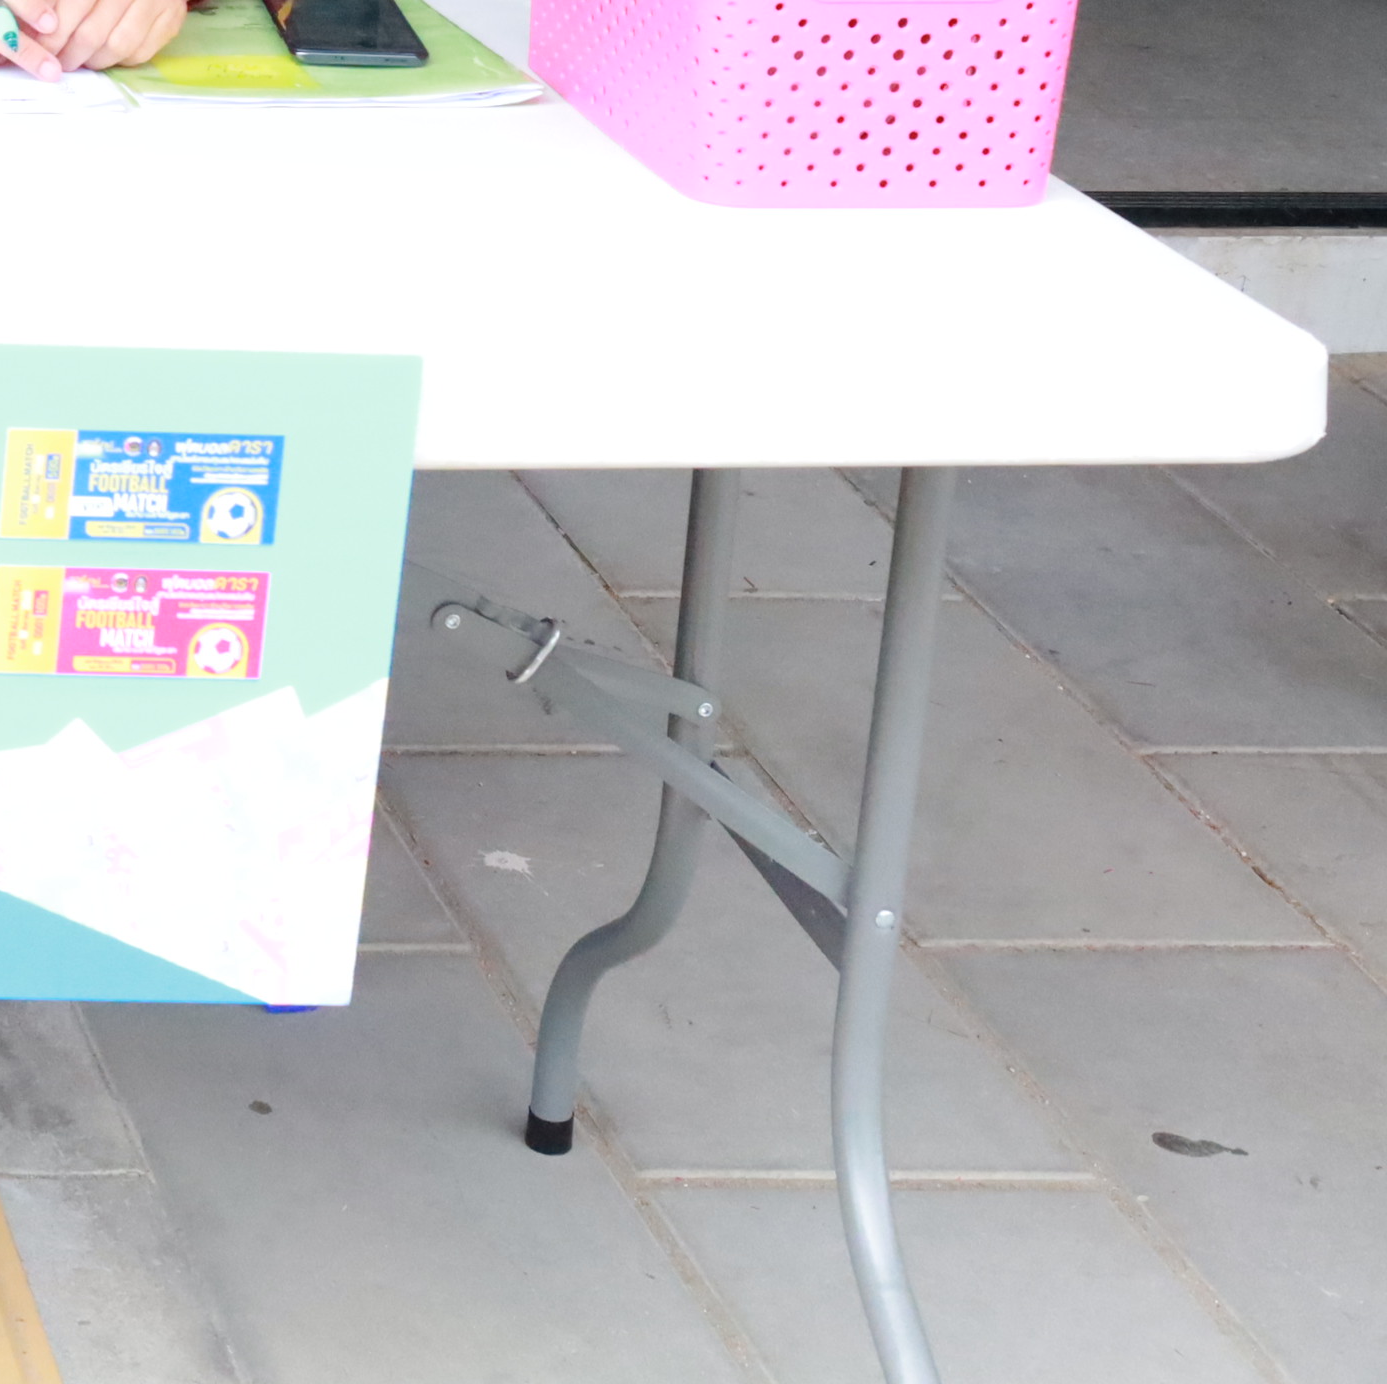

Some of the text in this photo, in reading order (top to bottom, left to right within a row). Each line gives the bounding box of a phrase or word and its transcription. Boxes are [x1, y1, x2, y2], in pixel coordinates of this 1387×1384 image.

[88, 474, 169, 494] FOOTBALL
[113, 492, 168, 514] MATCH
[75, 610, 156, 630] FOOTBALL
[99, 627, 155, 649] MATCH
